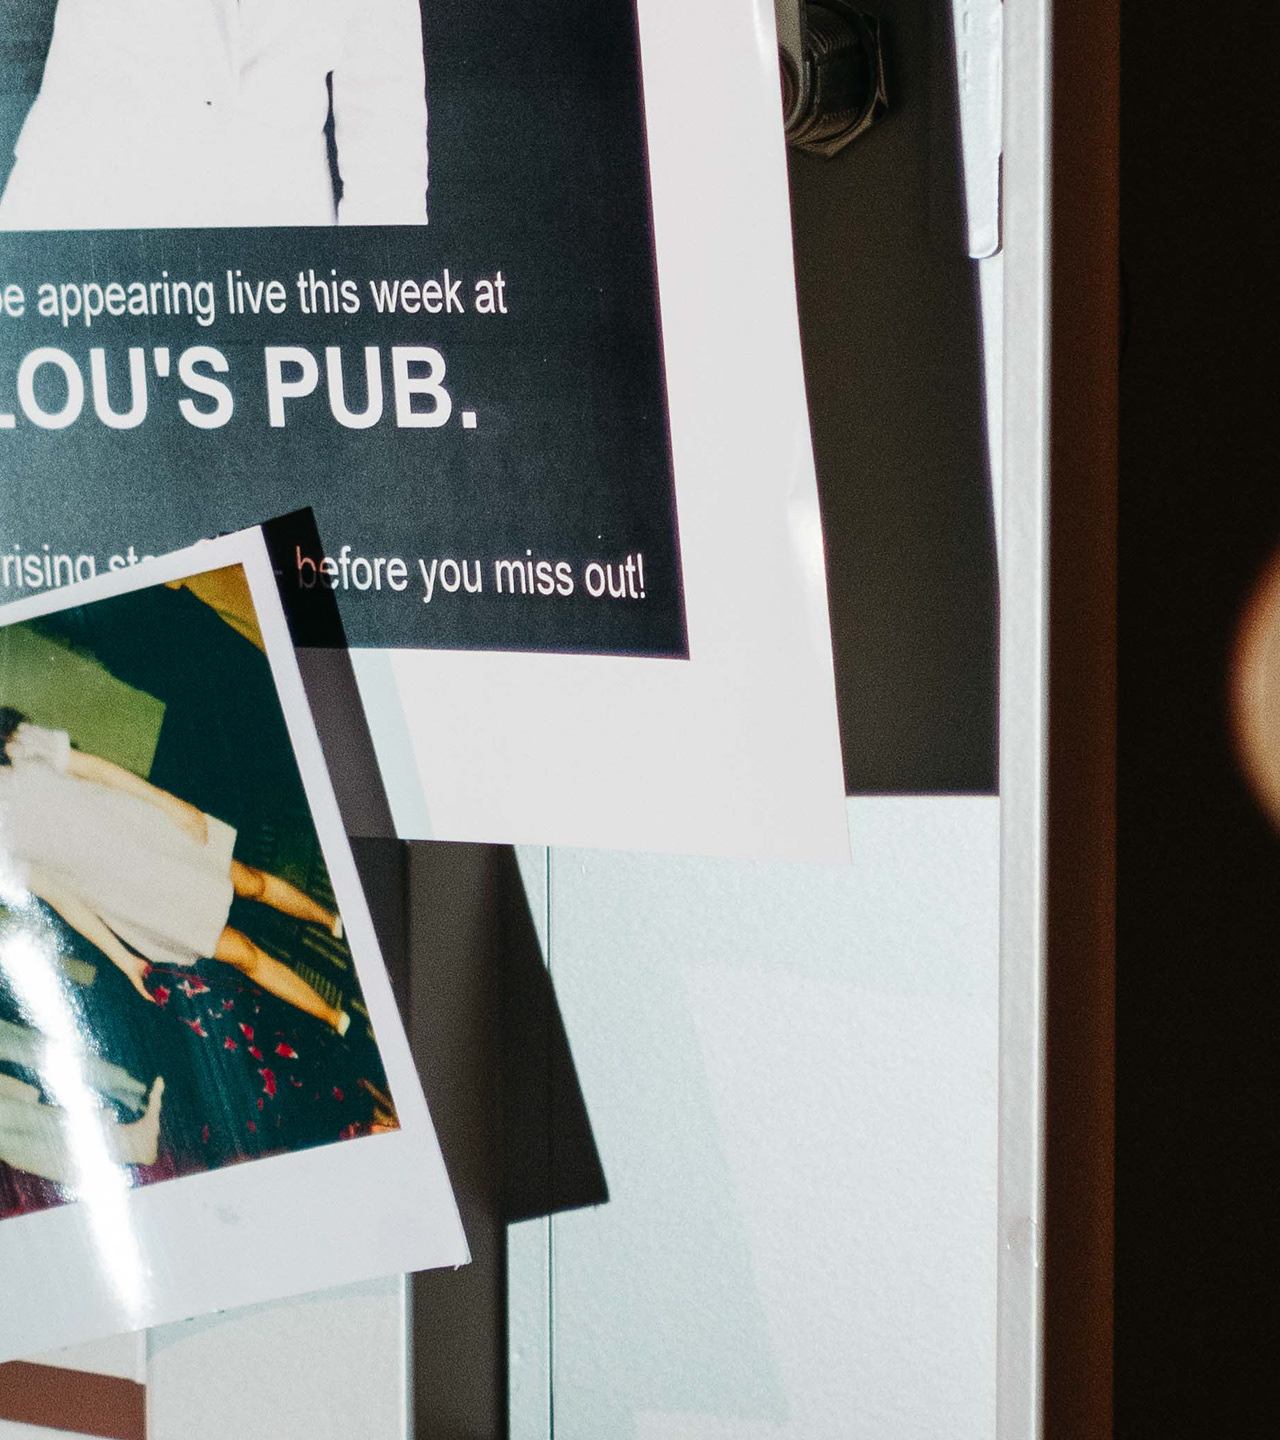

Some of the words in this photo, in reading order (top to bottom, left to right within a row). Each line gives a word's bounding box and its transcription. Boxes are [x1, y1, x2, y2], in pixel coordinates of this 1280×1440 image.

[37, 271, 216, 327] appearing
[226, 270, 287, 314] live
[296, 269, 361, 314] this
[368, 267, 465, 314] week
[474, 270, 508, 314] at
[264, 345, 478, 430] PUB.
[1, 544, 95, 586] rising
[296, 544, 410, 592] before
[418, 556, 483, 604] you
[493, 548, 575, 597] miss
[584, 552, 647, 601] out!
